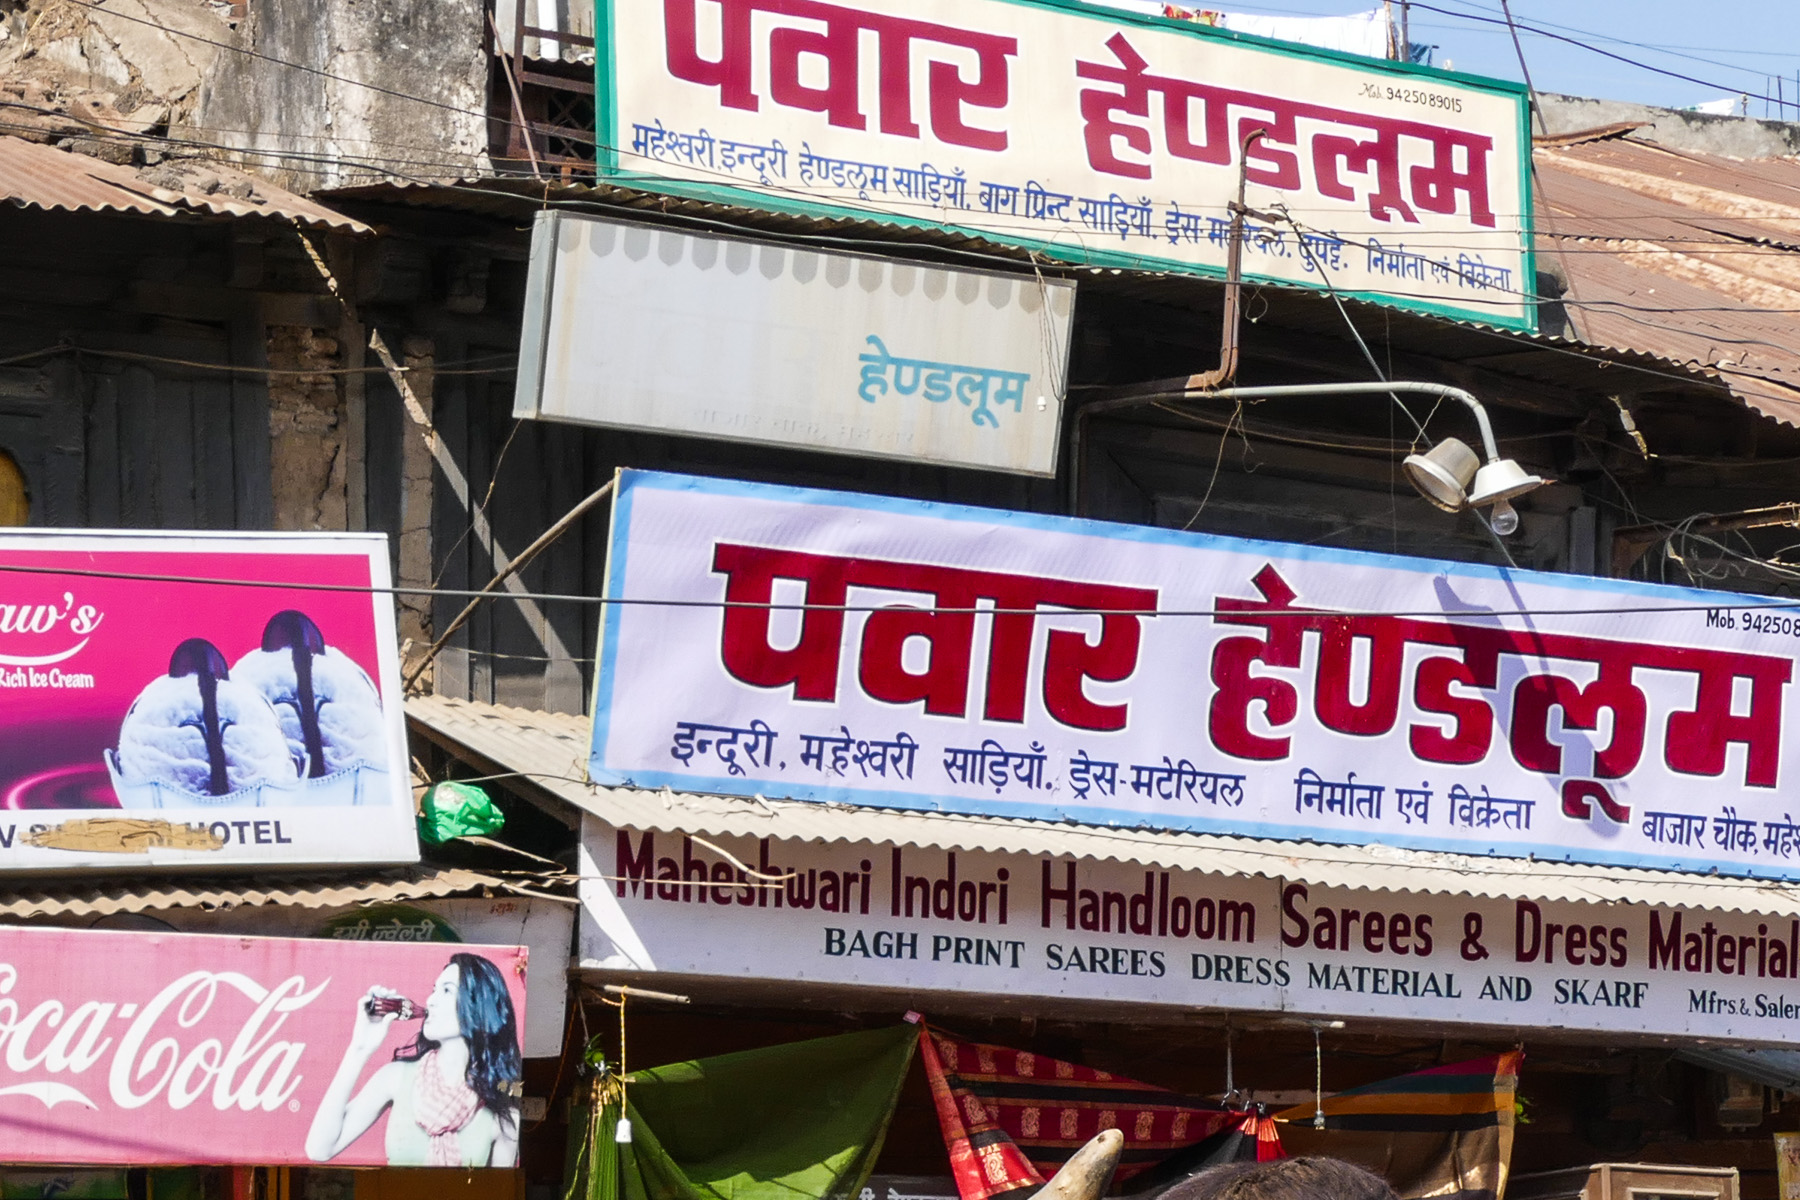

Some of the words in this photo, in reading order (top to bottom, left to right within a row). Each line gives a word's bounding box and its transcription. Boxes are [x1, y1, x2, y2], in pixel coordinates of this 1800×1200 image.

[664, 0, 1019, 153] पवार
[1076, 30, 1497, 229] हेण्डलूम
[1386, 87, 1462, 113] 9425089015
[799, 141, 889, 202] हेण्डलूम
[979, 181, 1020, 217] बाग
[1024, 179, 1074, 223] प्रिन्ट
[1366, 237, 1427, 282] निर्माता
[857, 333, 1031, 429] हेण्डलूम
[712, 542, 1159, 733] पवार
[1208, 562, 1795, 825] हेण्डलूम
[800, 725, 919, 781] महेश्वरी
[1293, 767, 1386, 820] निर्माता
[1395, 780, 1433, 825] एवं
[1447, 783, 1536, 831] विक्रेता
[1642, 810, 1708, 850] बाजार
[615, 828, 873, 916] Maheshwari
[890, 847, 1010, 926] Indori
[1040, 858, 1256, 945] Handloom
[1280, 883, 1434, 958] Sarees
[1459, 911, 1490, 962] &
[1515, 900, 1629, 969] Dress
[823, 926, 919, 962] BAGH
[931, 933, 1026, 970] PRINT
[1045, 943, 1167, 979] SAREES
[1190, 952, 1292, 988] DRESS
[1306, 962, 1463, 1001] MATERIAL
[1478, 975, 1534, 1004] AND
[1553, 978, 1650, 1010] SKARF
